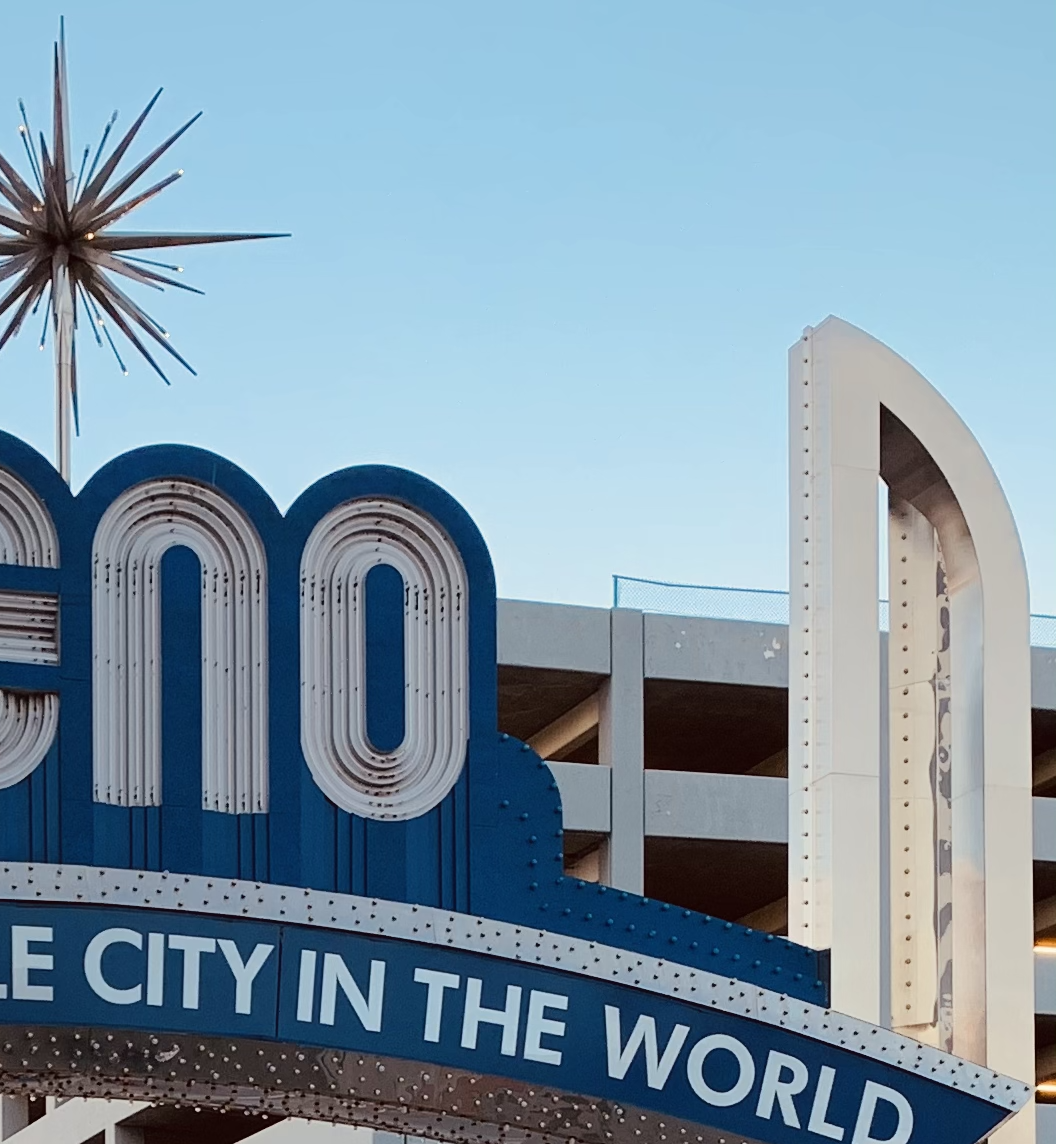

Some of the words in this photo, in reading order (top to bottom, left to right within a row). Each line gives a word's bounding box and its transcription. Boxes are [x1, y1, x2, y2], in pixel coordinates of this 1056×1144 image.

[83, 928, 275, 1016] CITY
[296, 948, 387, 1033] IN
[412, 967, 569, 1066] THE
